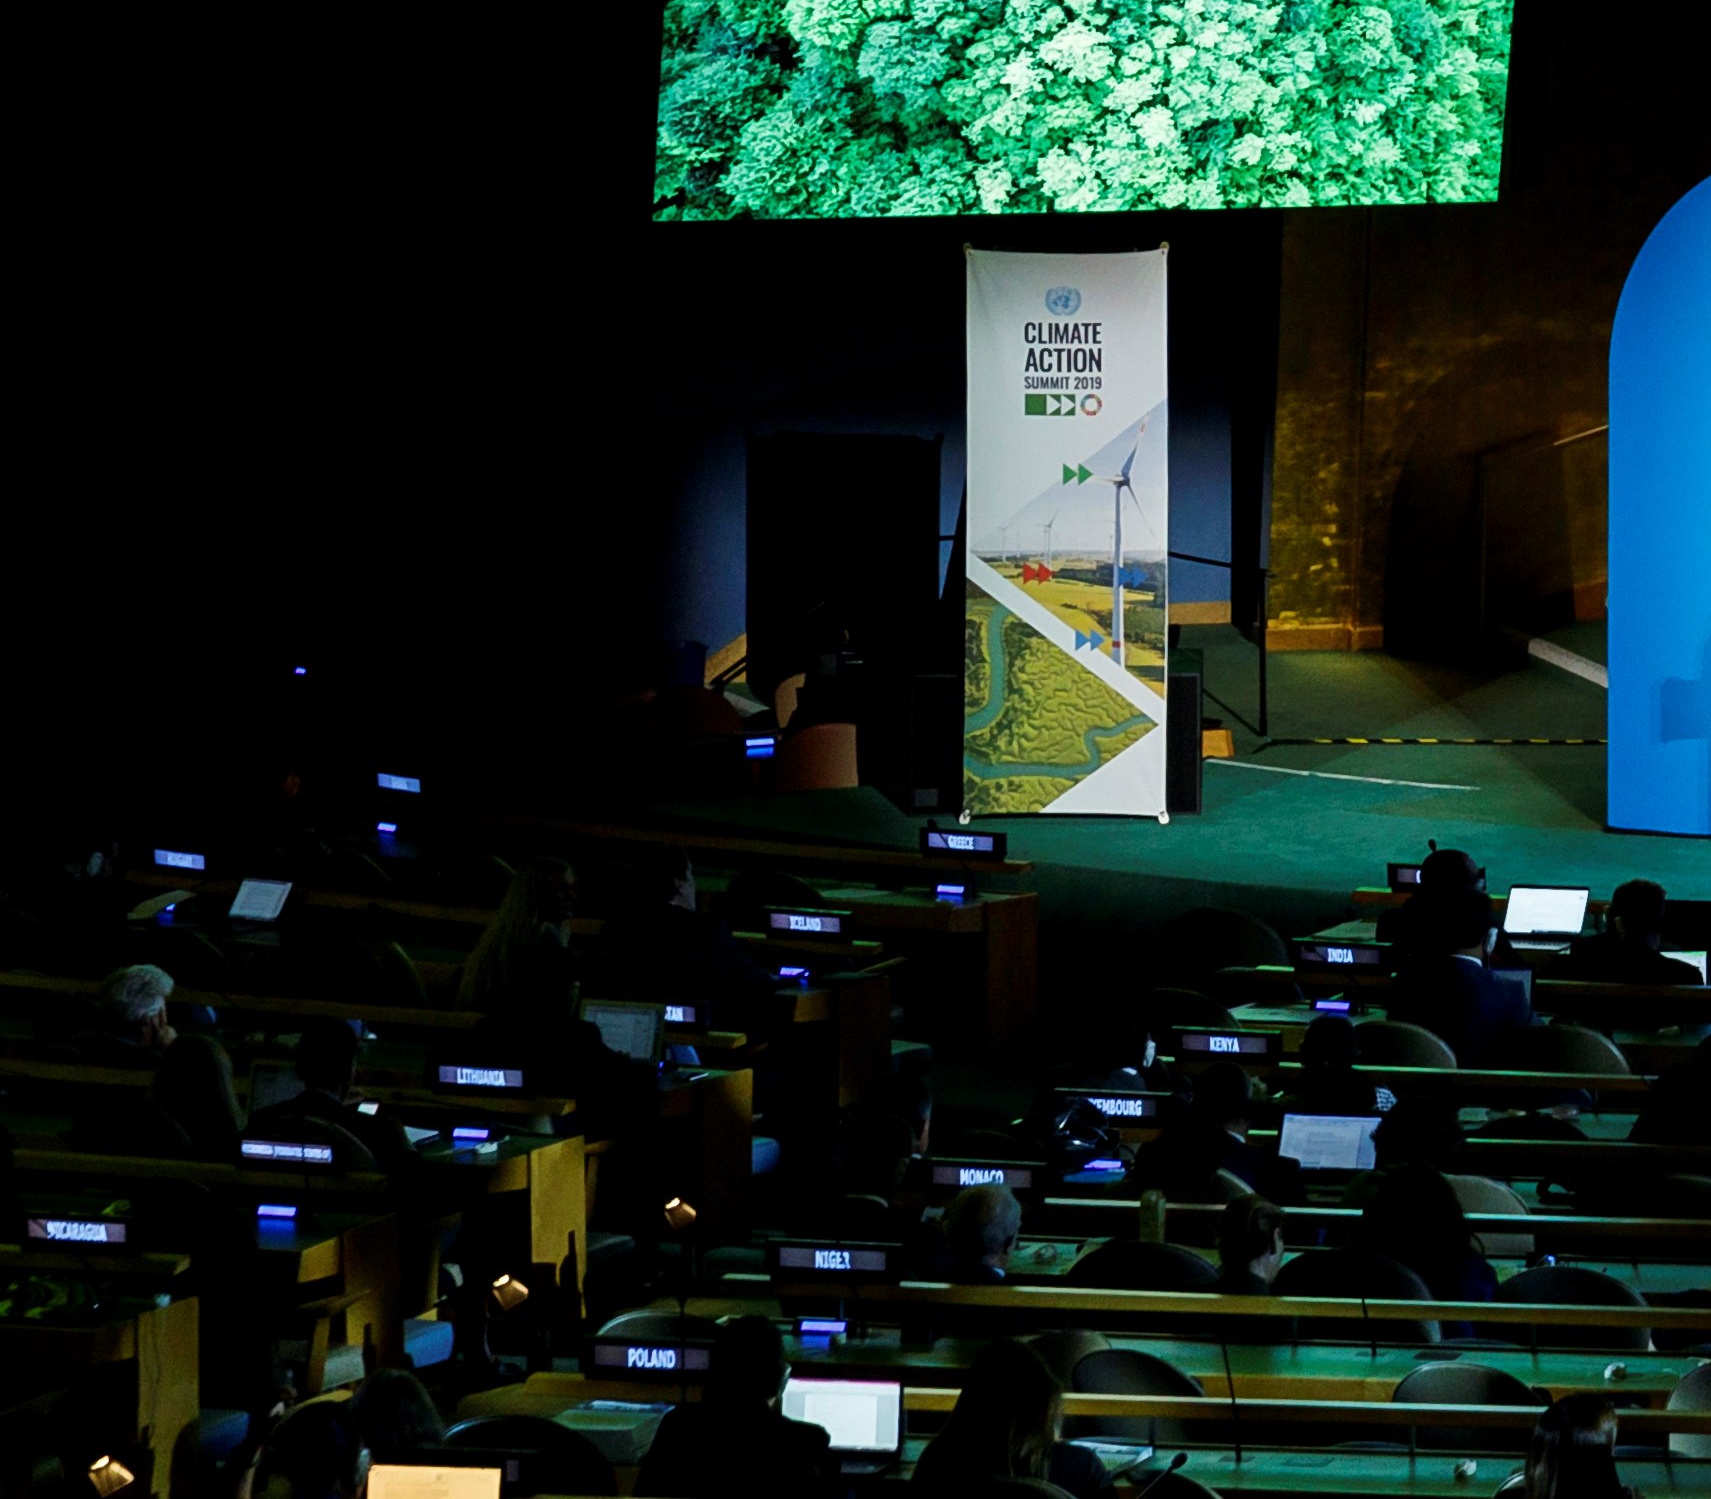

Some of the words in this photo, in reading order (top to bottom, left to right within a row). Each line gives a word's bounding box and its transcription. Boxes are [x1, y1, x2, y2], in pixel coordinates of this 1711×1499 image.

[1024, 321, 1102, 345] CLIMATE
[1024, 347, 1102, 373] ACTION
[1024, 376, 1069, 390] SUMMIT
[1073, 376, 1103, 390] 2019
[1327, 947, 1354, 963] INDIA
[1209, 1036, 1240, 1053] KENYA
[815, 1250, 852, 1270] NIGER
[627, 1347, 677, 1370] POLAND
